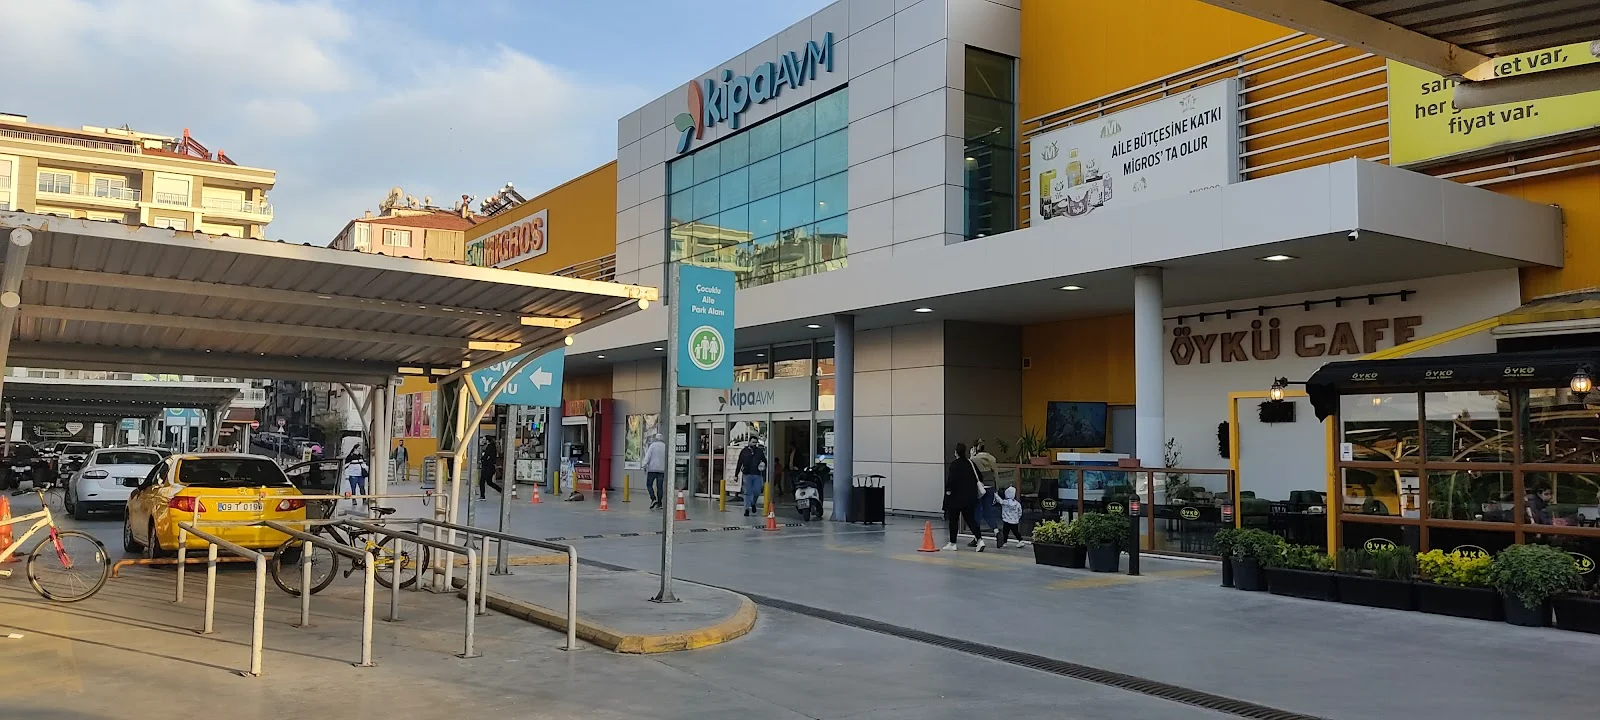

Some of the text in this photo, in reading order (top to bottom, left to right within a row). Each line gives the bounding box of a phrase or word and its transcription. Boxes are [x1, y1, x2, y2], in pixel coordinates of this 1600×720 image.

[1527, 48, 1569, 69] var,
[1415, 101, 1447, 119] her
[1448, 104, 1539, 135] fiyat var.
[1111, 106, 1222, 159] AİLE BÜTÇESİNE KATKI
[1123, 135, 1208, 176] MİGROS' TA OLUR
[696, 284, 722, 295] Çocuklu
[702, 295, 715, 305] Aile
[692, 305, 725, 316] Park Alanı
[1170, 315, 1423, 366] ÖYKÜ CAFE
[730, 387, 775, 411] kipaAVM
[222, 503, 232, 511] 09
